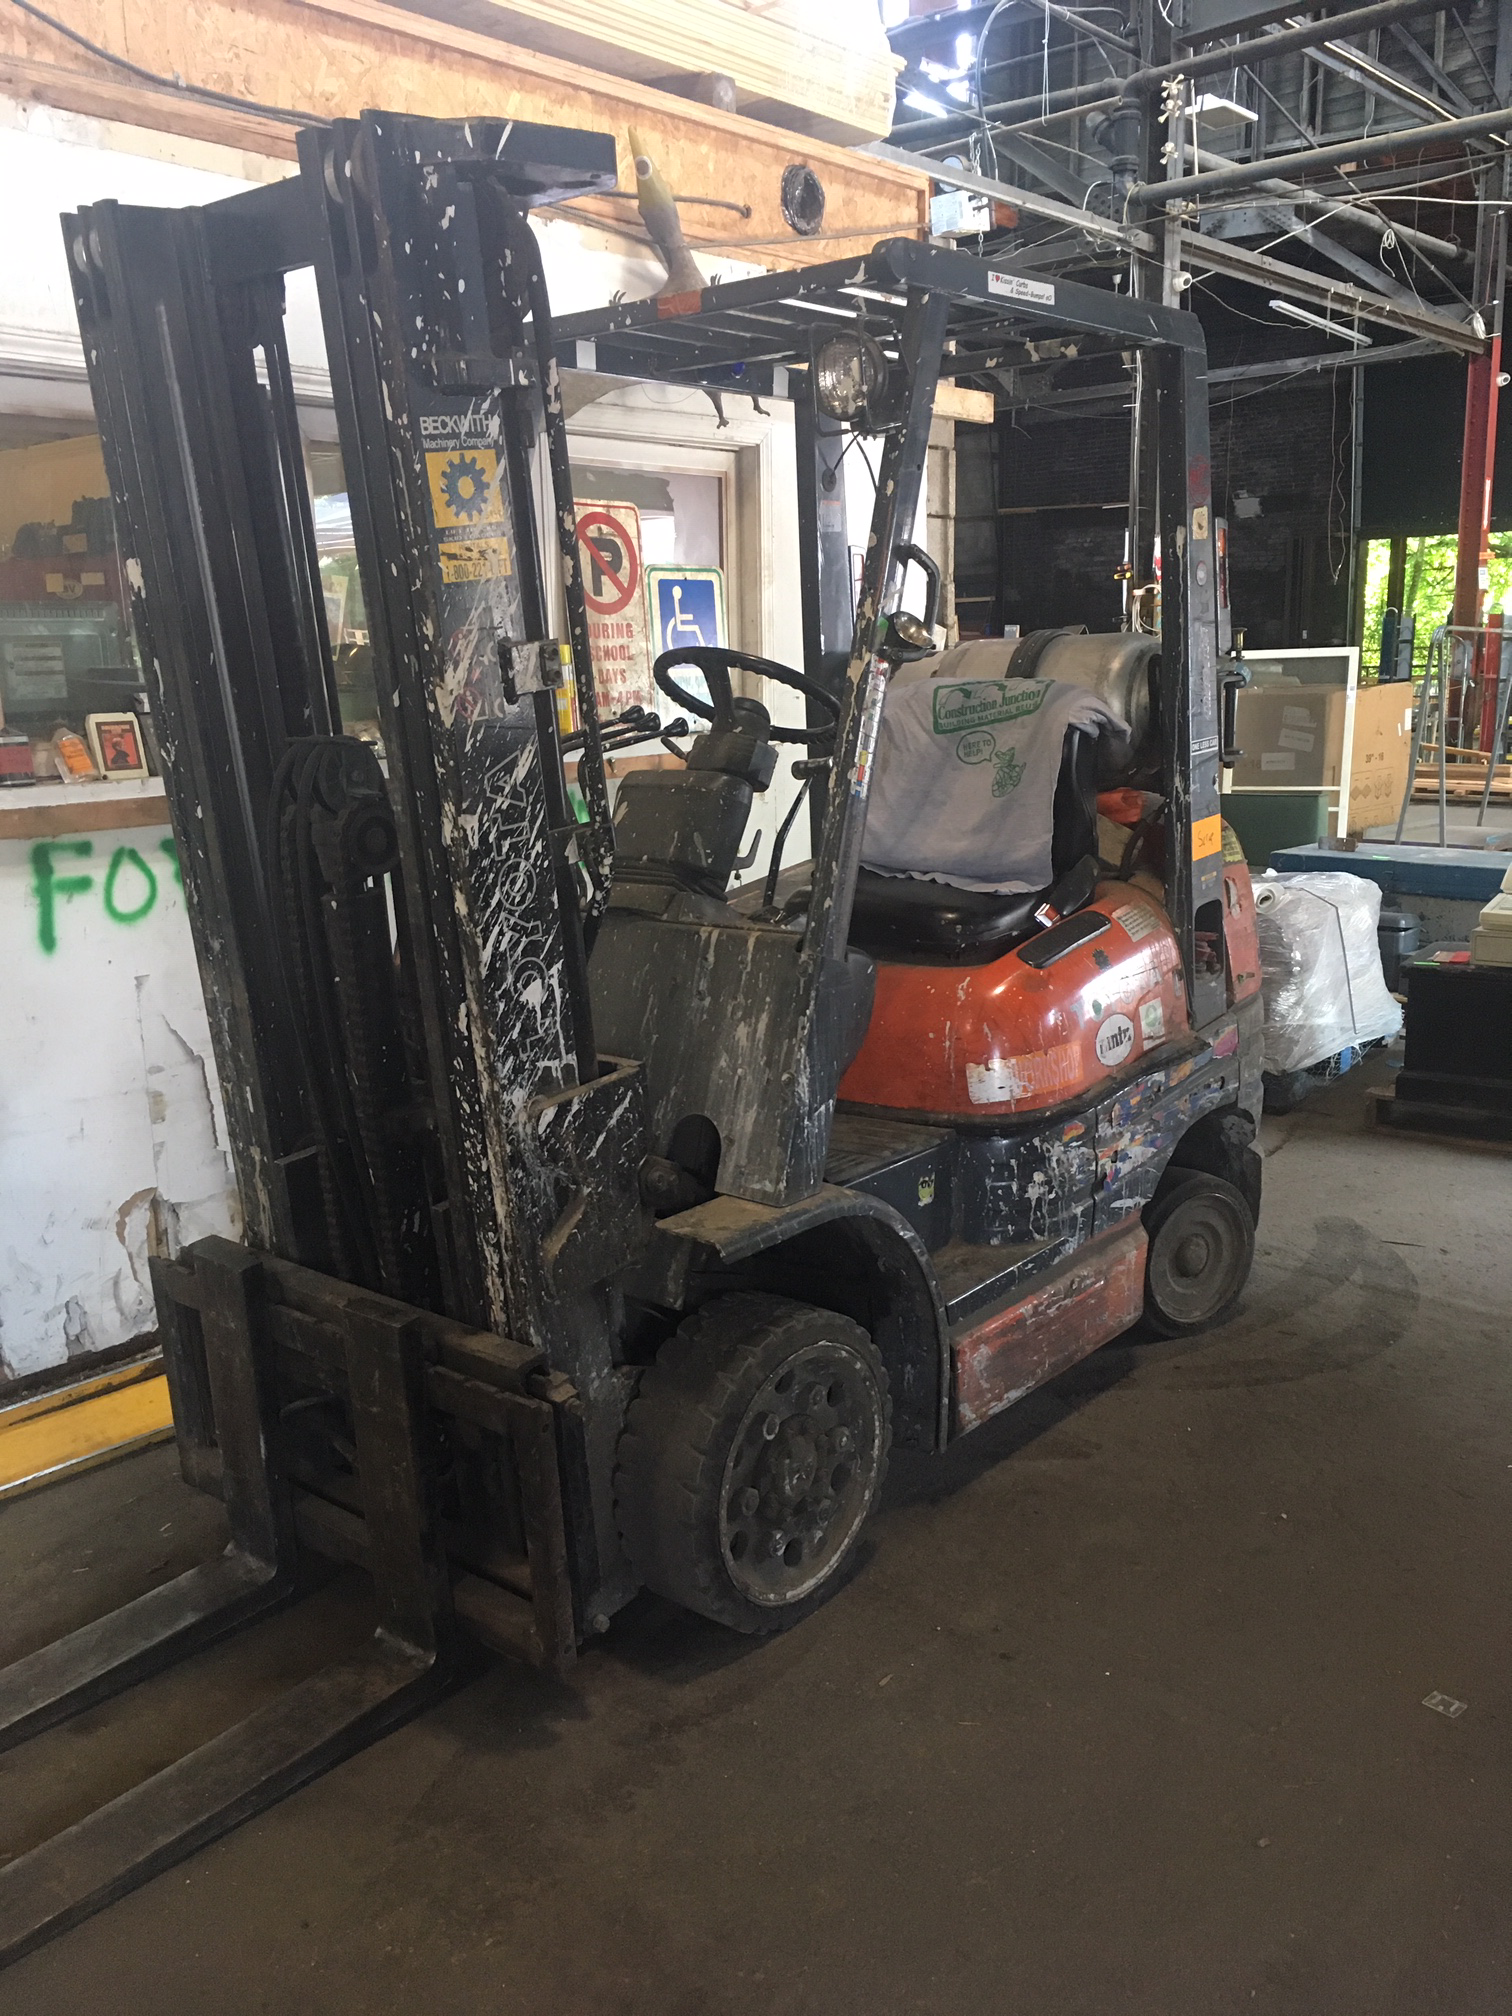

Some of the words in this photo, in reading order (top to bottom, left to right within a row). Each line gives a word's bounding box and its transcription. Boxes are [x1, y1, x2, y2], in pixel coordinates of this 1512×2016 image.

[1016, 280, 1028, 289] Curbs
[420, 413, 494, 435] BECKWITH
[422, 437, 460, 449] Machinery
[590, 644, 634, 661] SCHOOL
[597, 667, 627, 685] DAYS
[938, 698, 998, 720] Construction
[999, 689, 1040, 708] Junction
[938, 716, 976, 729] BUILDING
[977, 707, 1013, 722] MATERIAL
[963, 741, 981, 751] HERE
[982, 739, 992, 747] TO
[1192, 742, 1200, 752] ONE
[1200, 740, 1209, 749] LESS
[964, 749, 983, 759] HELP!
